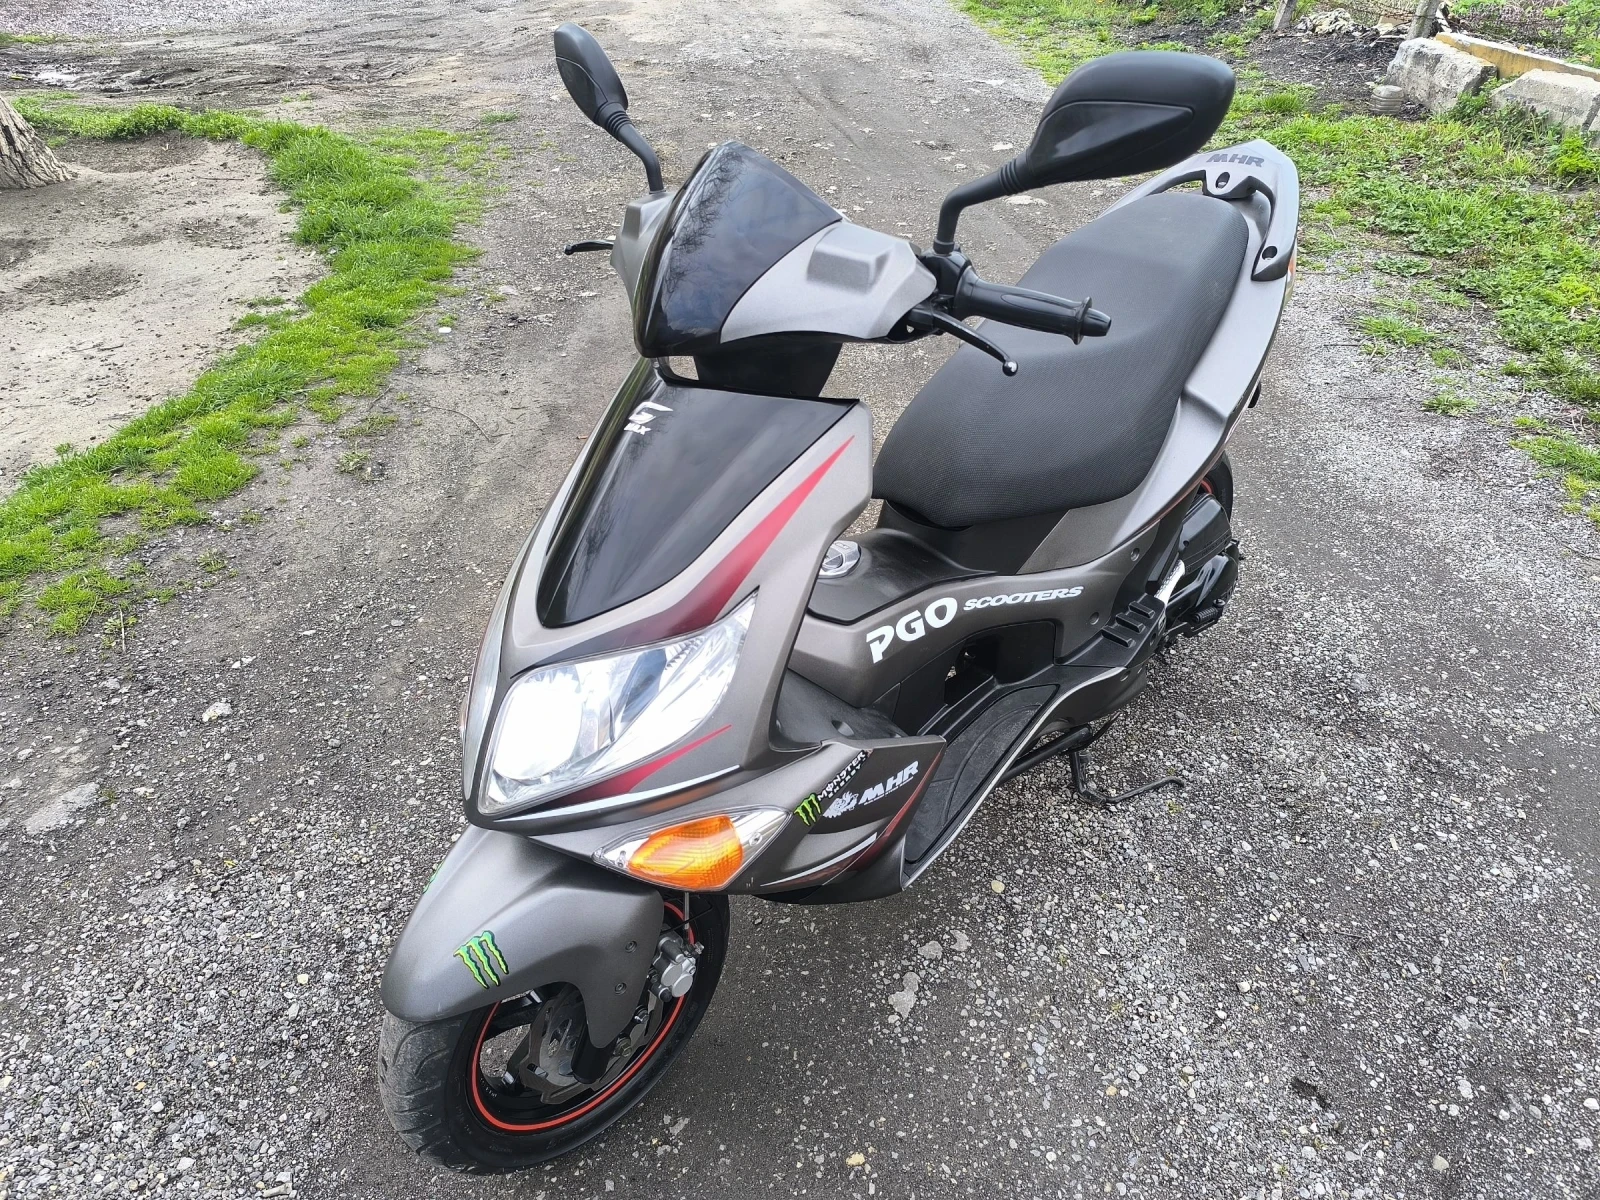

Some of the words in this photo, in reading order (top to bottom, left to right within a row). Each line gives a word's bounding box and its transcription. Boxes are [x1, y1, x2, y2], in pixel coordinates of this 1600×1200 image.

[1206, 153, 1265, 168] MHR
[866, 597, 958, 664] PGO
[963, 586, 1085, 611] SCOOTERS
[817, 751, 866, 802] MONSTER
[858, 760, 919, 805] MHR
